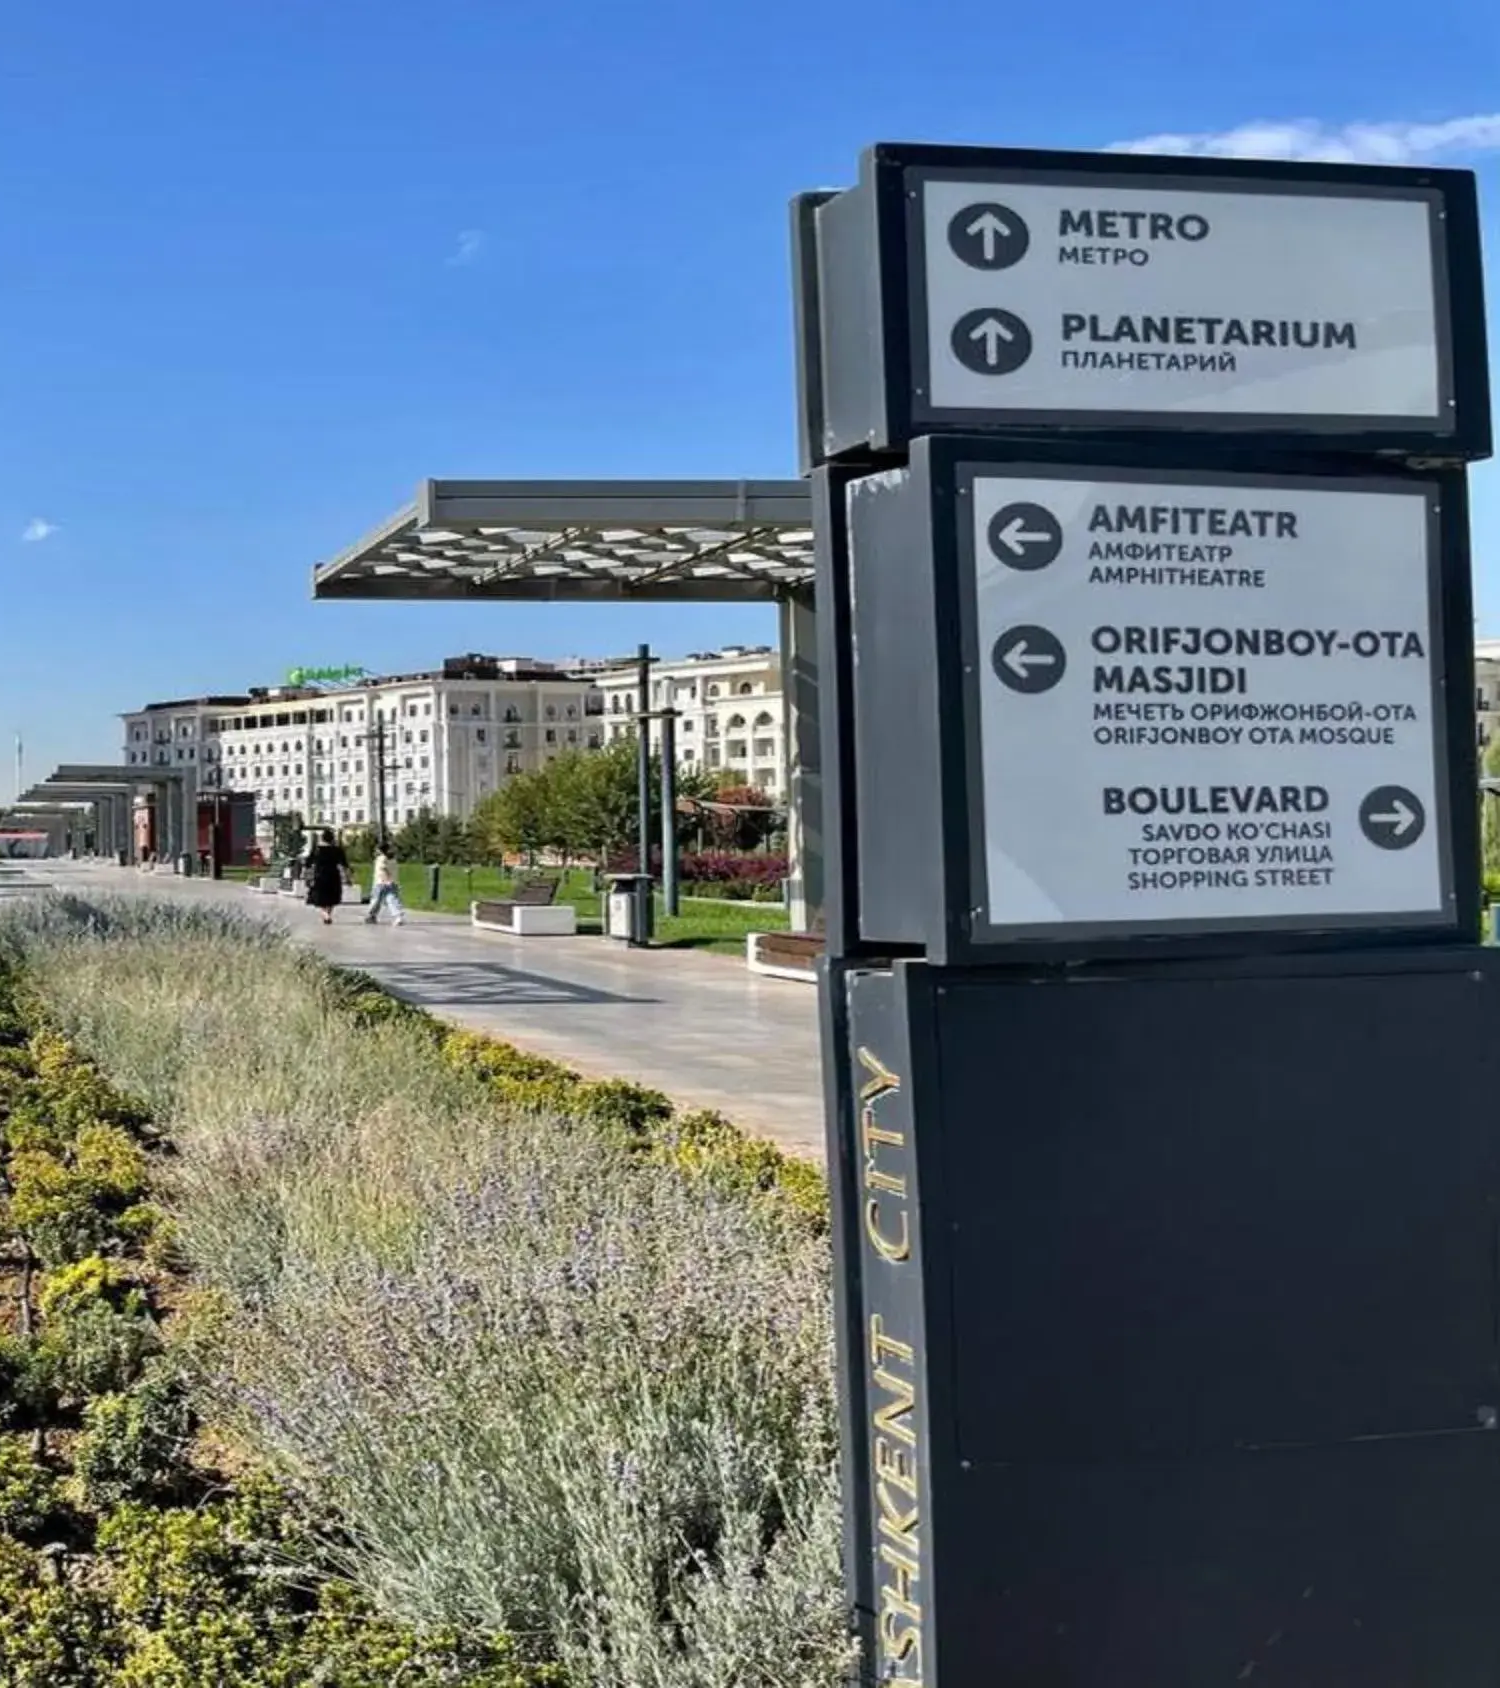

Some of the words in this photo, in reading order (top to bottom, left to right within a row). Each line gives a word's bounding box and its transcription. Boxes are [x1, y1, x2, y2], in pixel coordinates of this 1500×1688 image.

[1058, 209, 1211, 242] METRO
[1058, 245, 1150, 267] МЕТРО
[1061, 313, 1358, 349] PLANETARIUM
[1061, 348, 1237, 373] ПЛАНЕТАРИЙ
[1088, 504, 1299, 539] AMFITEATR
[1088, 543, 1233, 563] АМФИТЕАТР
[1088, 567, 1266, 588] AMPHITHEATRE
[1090, 625, 1425, 659] ORIFJONBOY-OTA
[1093, 666, 1247, 696] MASJIDI
[1093, 703, 1185, 722] МЕЧЕТЬ
[1189, 701, 1417, 722] ОРИФЖОНБОЙ-ОТА
[1093, 726, 1242, 746] ORIFJONBOY
[1249, 726, 1295, 746] OTA
[1299, 726, 1395, 747] MOSQUE
[1102, 785, 1330, 816] BOULEVARD
[1141, 821, 1221, 842] SAVDO
[1129, 846, 1251, 867] ТОРГОВАЯ
[1257, 845, 1334, 867] УЛИЦА
[1127, 868, 1250, 891] SHOPPING
[1255, 867, 1335, 888] STREET
[857, 1045, 909, 1264] CITY
[870, 1313, 923, 1688] SHKENT
